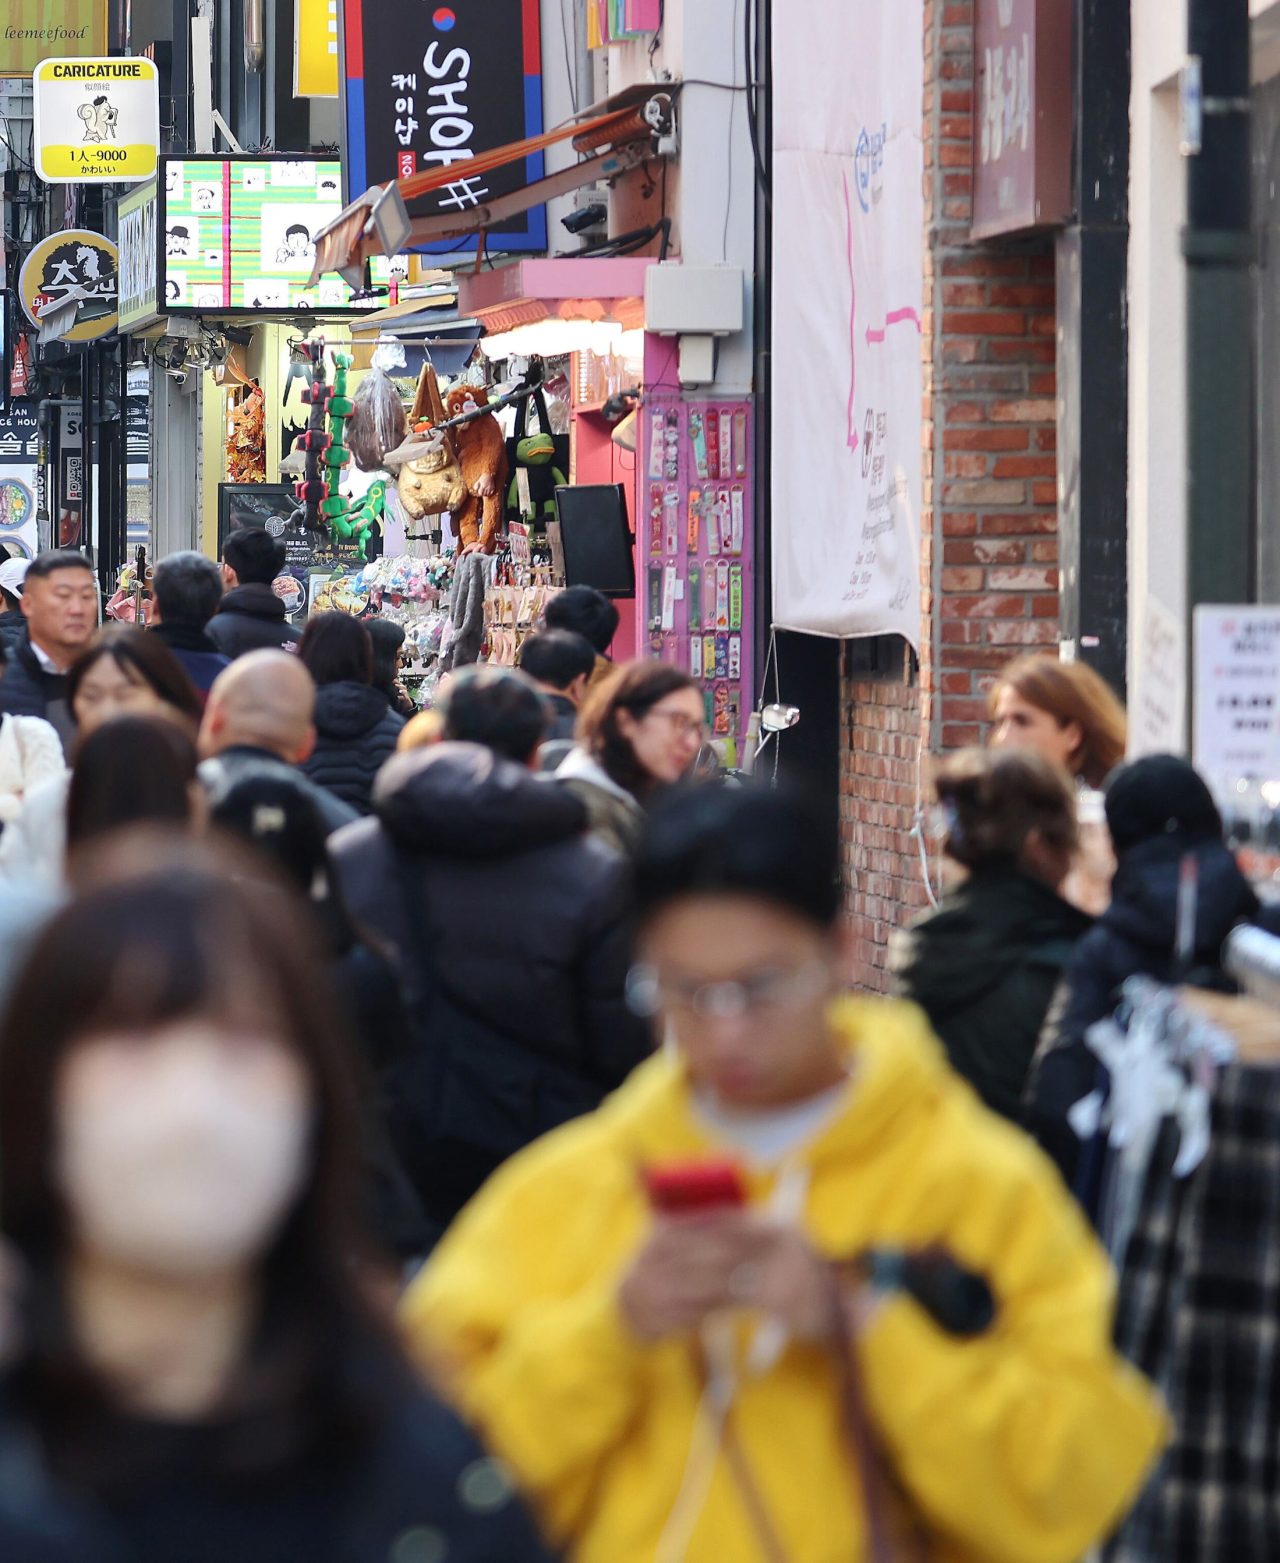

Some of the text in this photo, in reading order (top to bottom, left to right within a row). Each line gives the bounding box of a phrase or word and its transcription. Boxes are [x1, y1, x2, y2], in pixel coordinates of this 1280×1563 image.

[4, 25, 89, 42] leemeefood
[53, 64, 141, 78] CARICATURE
[391, 73, 419, 146] 케이샵
[80, 165, 117, 174] かわいい
